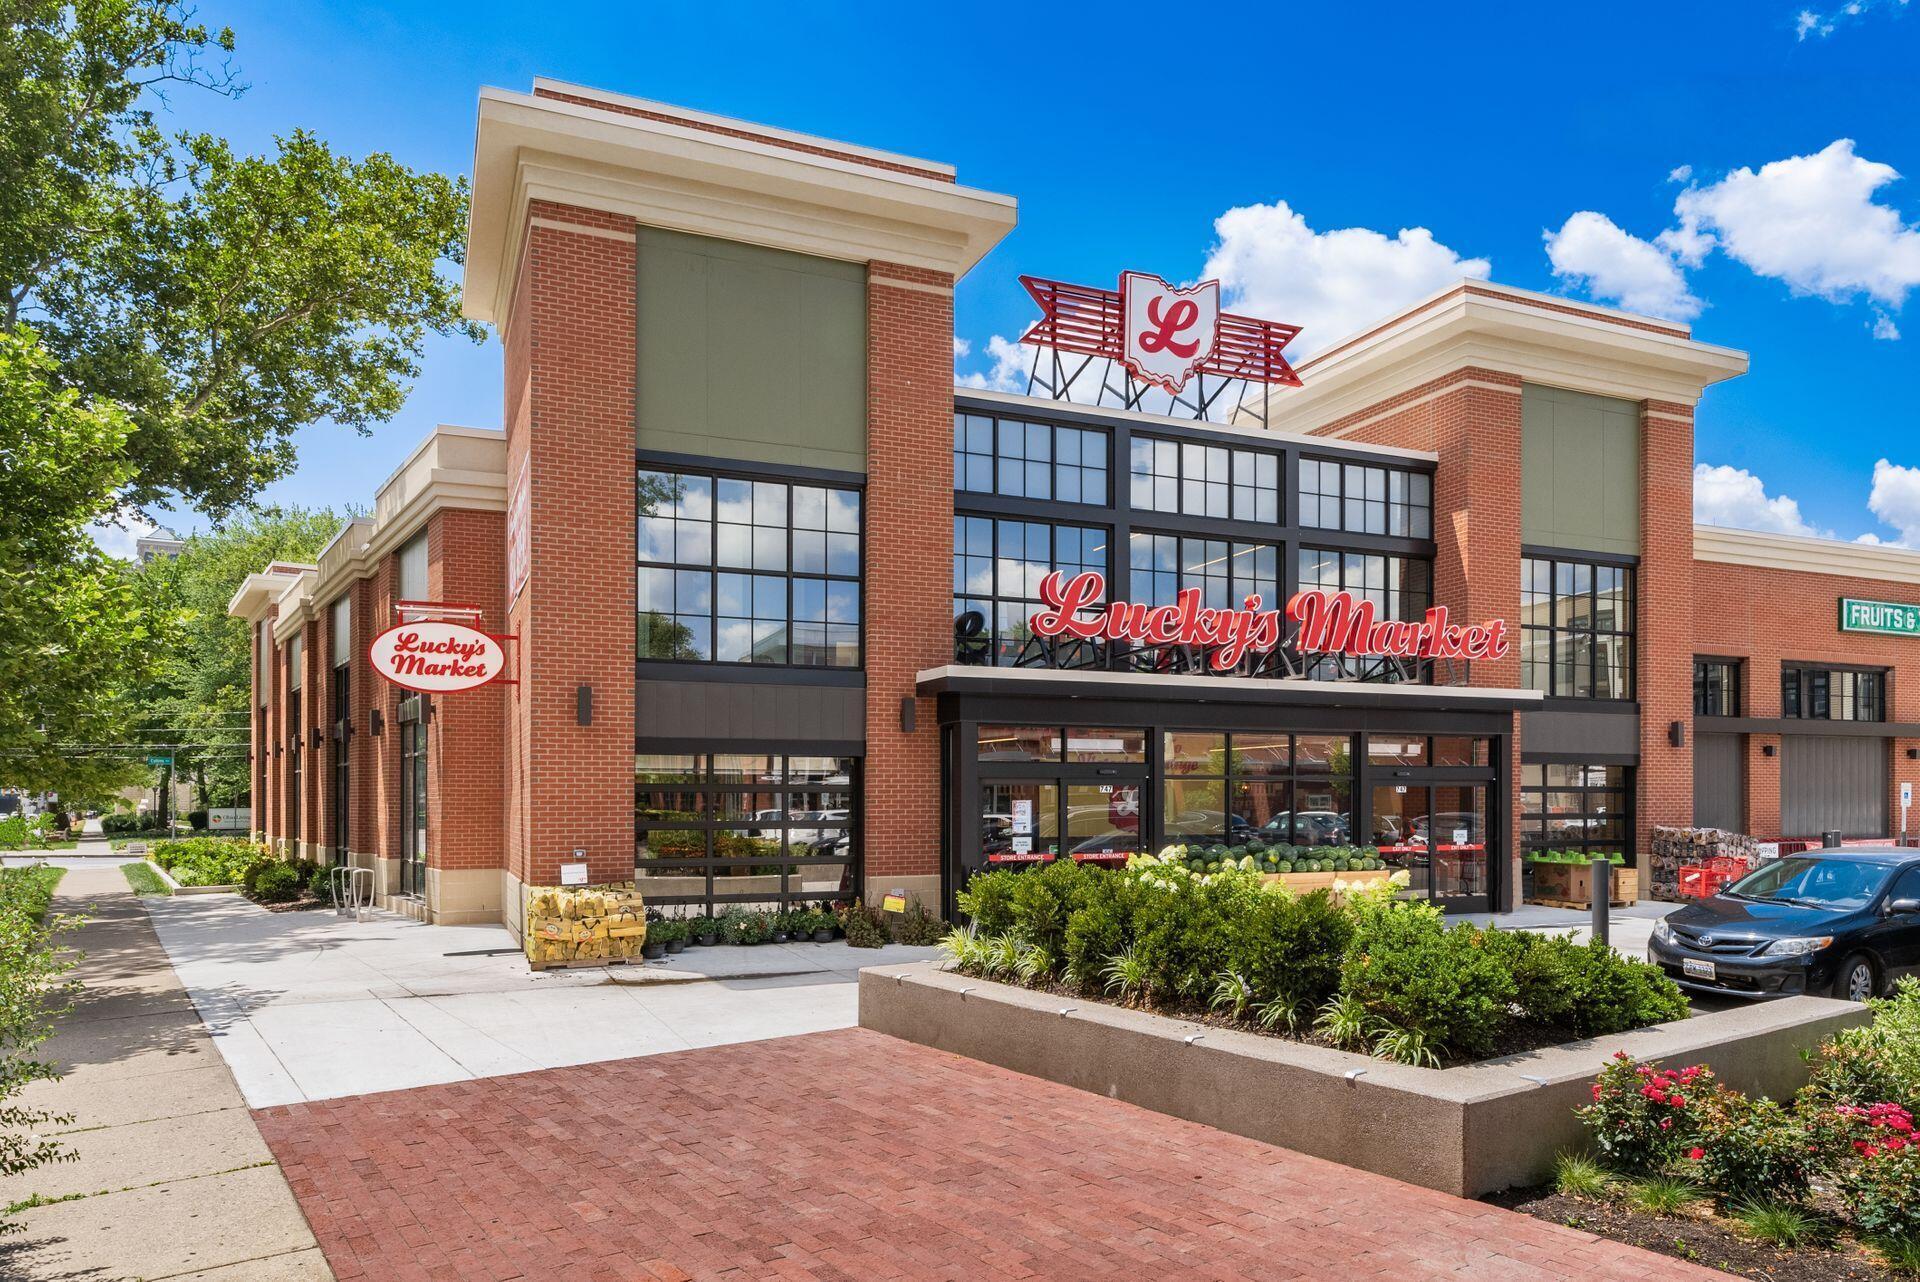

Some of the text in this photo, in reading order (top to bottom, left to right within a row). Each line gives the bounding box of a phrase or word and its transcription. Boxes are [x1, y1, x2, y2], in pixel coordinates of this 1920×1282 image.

[1138, 295, 1200, 358] L
[1029, 569, 1510, 672] Lucky's Market
[1851, 604, 1903, 629] FRUITS
[390, 632, 487, 678] Lucky's Market
[1100, 785, 1112, 793] 747
